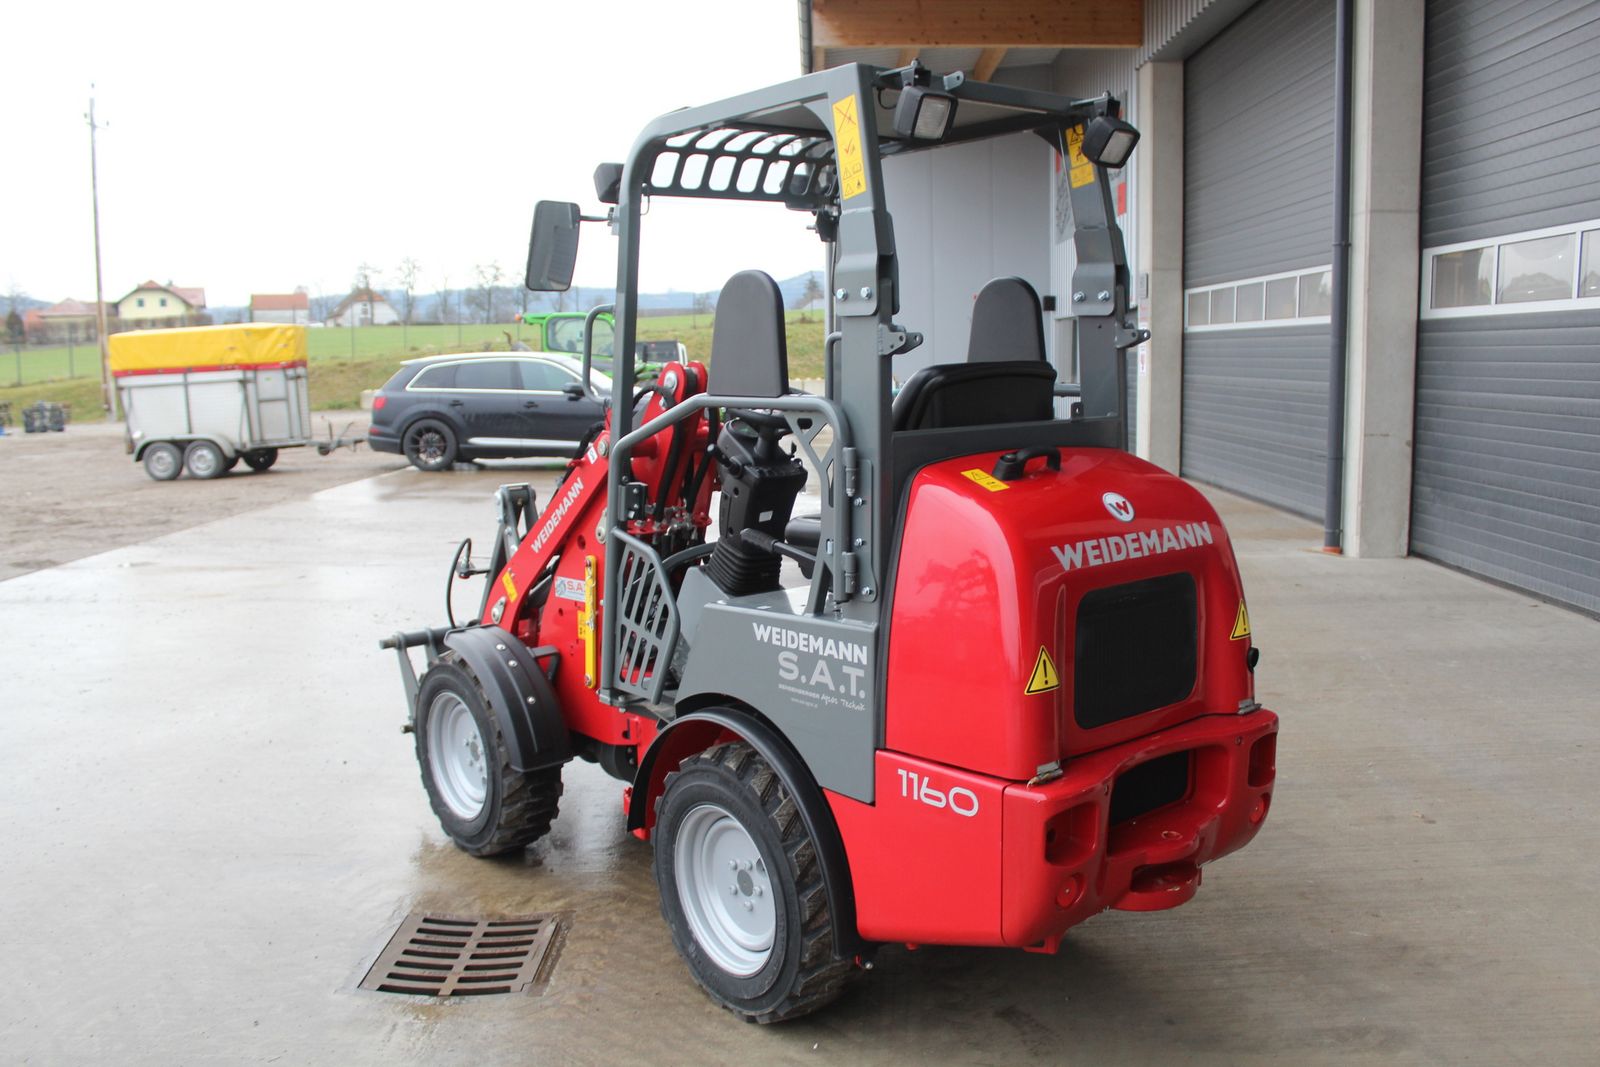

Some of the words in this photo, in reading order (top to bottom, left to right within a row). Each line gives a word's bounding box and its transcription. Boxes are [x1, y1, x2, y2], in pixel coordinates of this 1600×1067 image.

[531, 477, 584, 553] WEIDEMANN
[1051, 521, 1213, 571] WEIDEMANN
[752, 622, 868, 665] WEIDEMANN
[778, 651, 866, 699] S.A.T.
[897, 768, 979, 817] 1160
